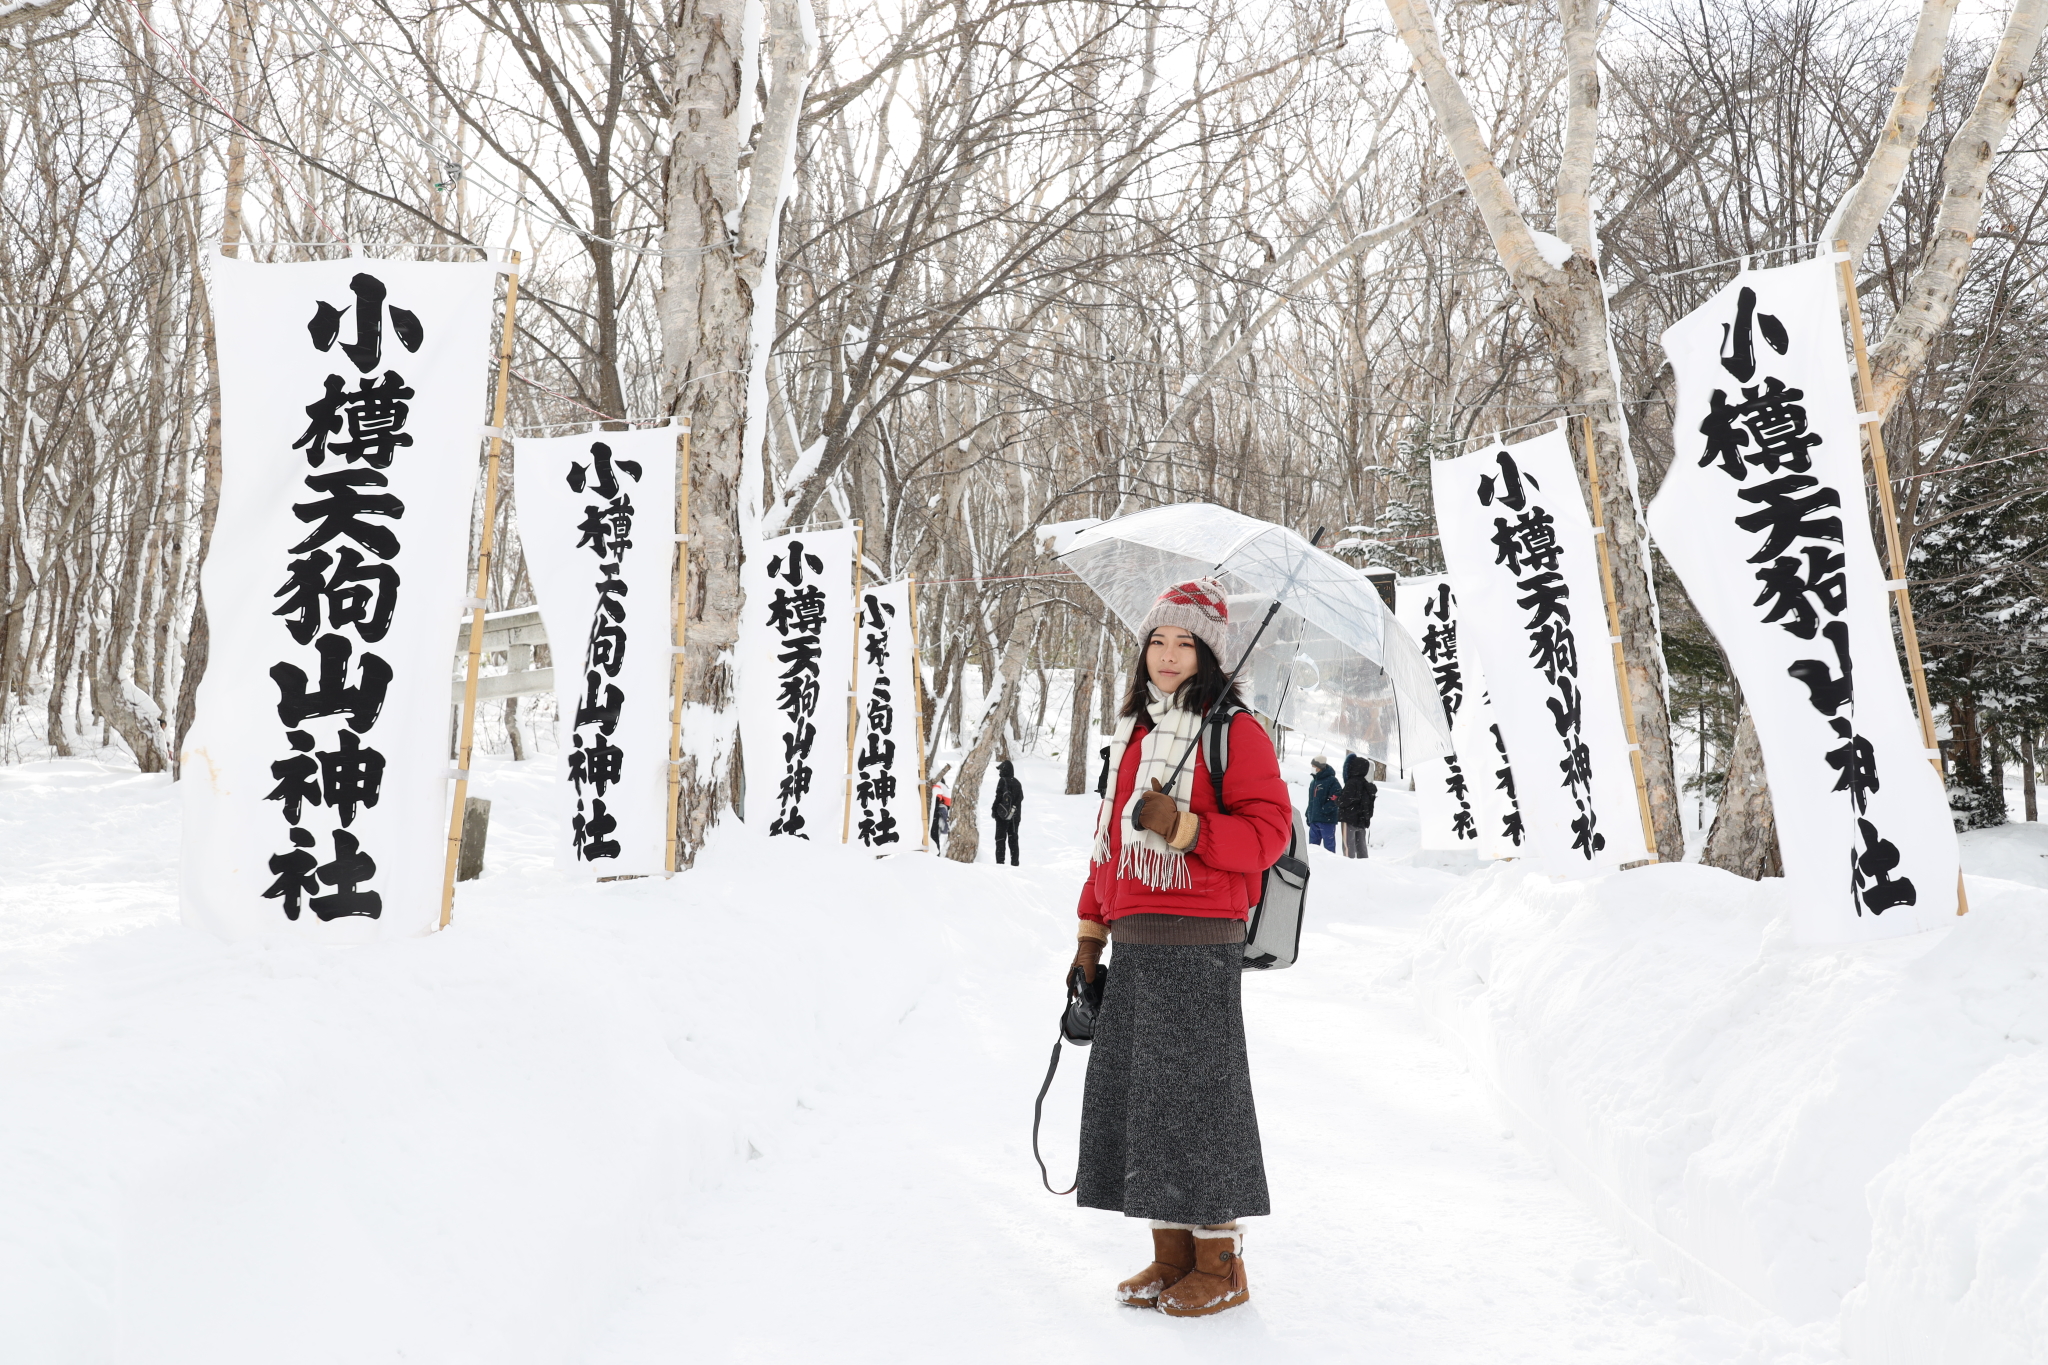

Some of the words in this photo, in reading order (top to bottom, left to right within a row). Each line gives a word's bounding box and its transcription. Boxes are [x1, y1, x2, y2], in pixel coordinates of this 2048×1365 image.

[262, 273, 423, 921] 小樽天狗山神社
[566, 441, 643, 862] 小樽天狗山神社
[766, 541, 826, 840] 小樽天狗山神社
[1476, 451, 1605, 860] 小樽天狗山神社
[1698, 286, 1916, 917] 小樽天狗山神社
